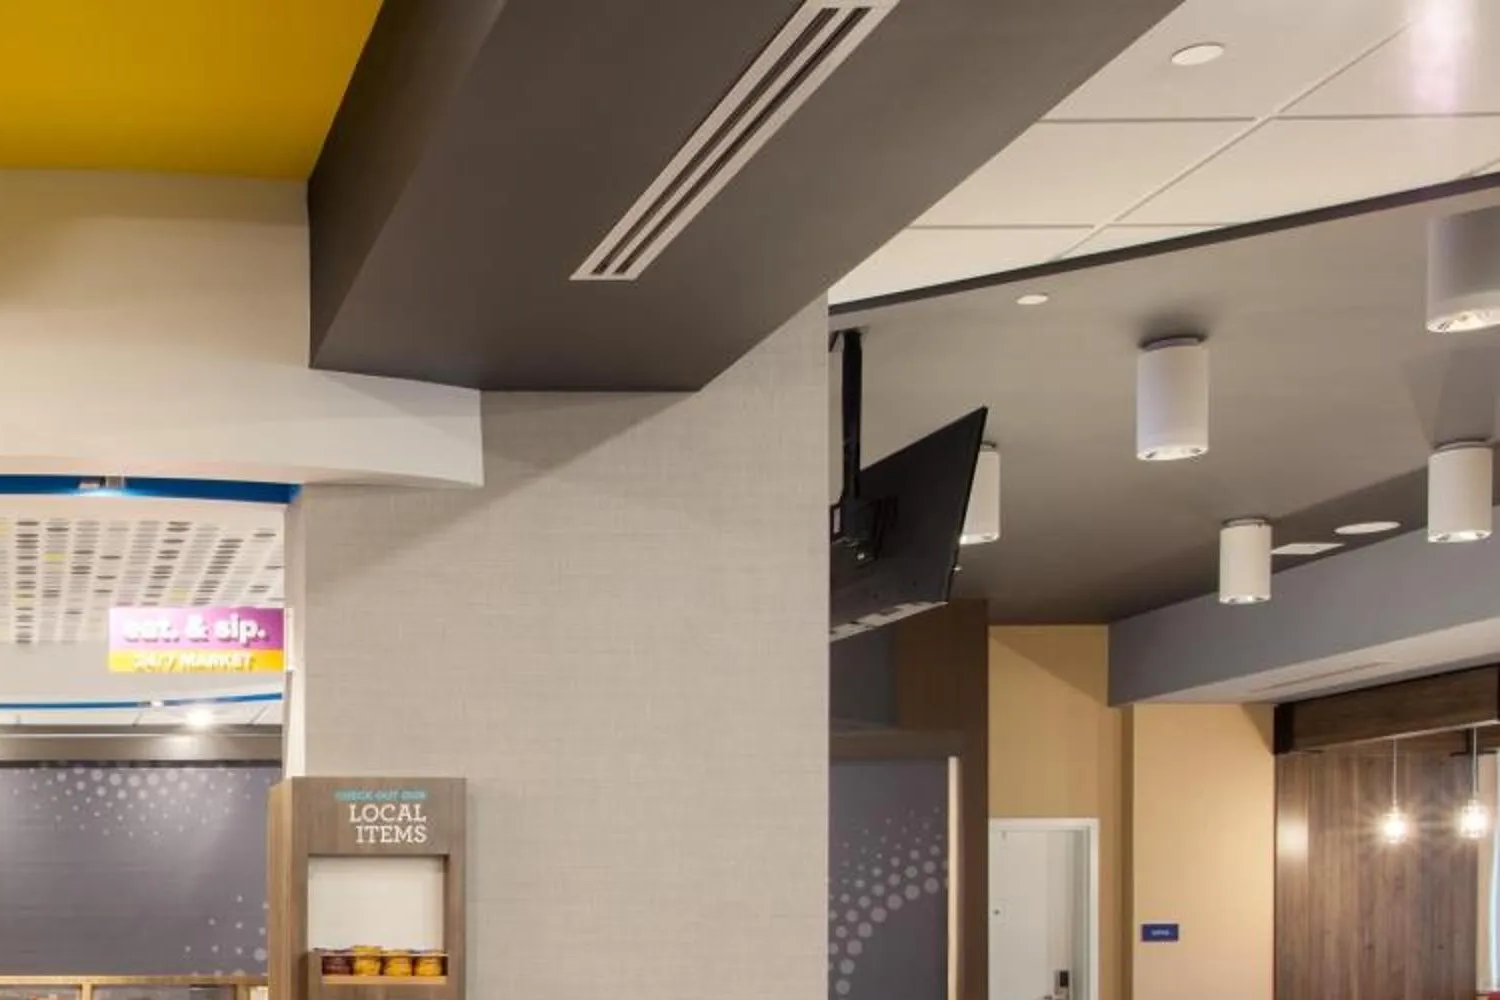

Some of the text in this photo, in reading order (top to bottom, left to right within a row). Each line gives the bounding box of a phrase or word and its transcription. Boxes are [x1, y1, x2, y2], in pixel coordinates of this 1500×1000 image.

[185, 612, 211, 641] &
[215, 612, 268, 647] sip.
[349, 803, 426, 822] LOCAL
[356, 825, 427, 843] ITEMS
